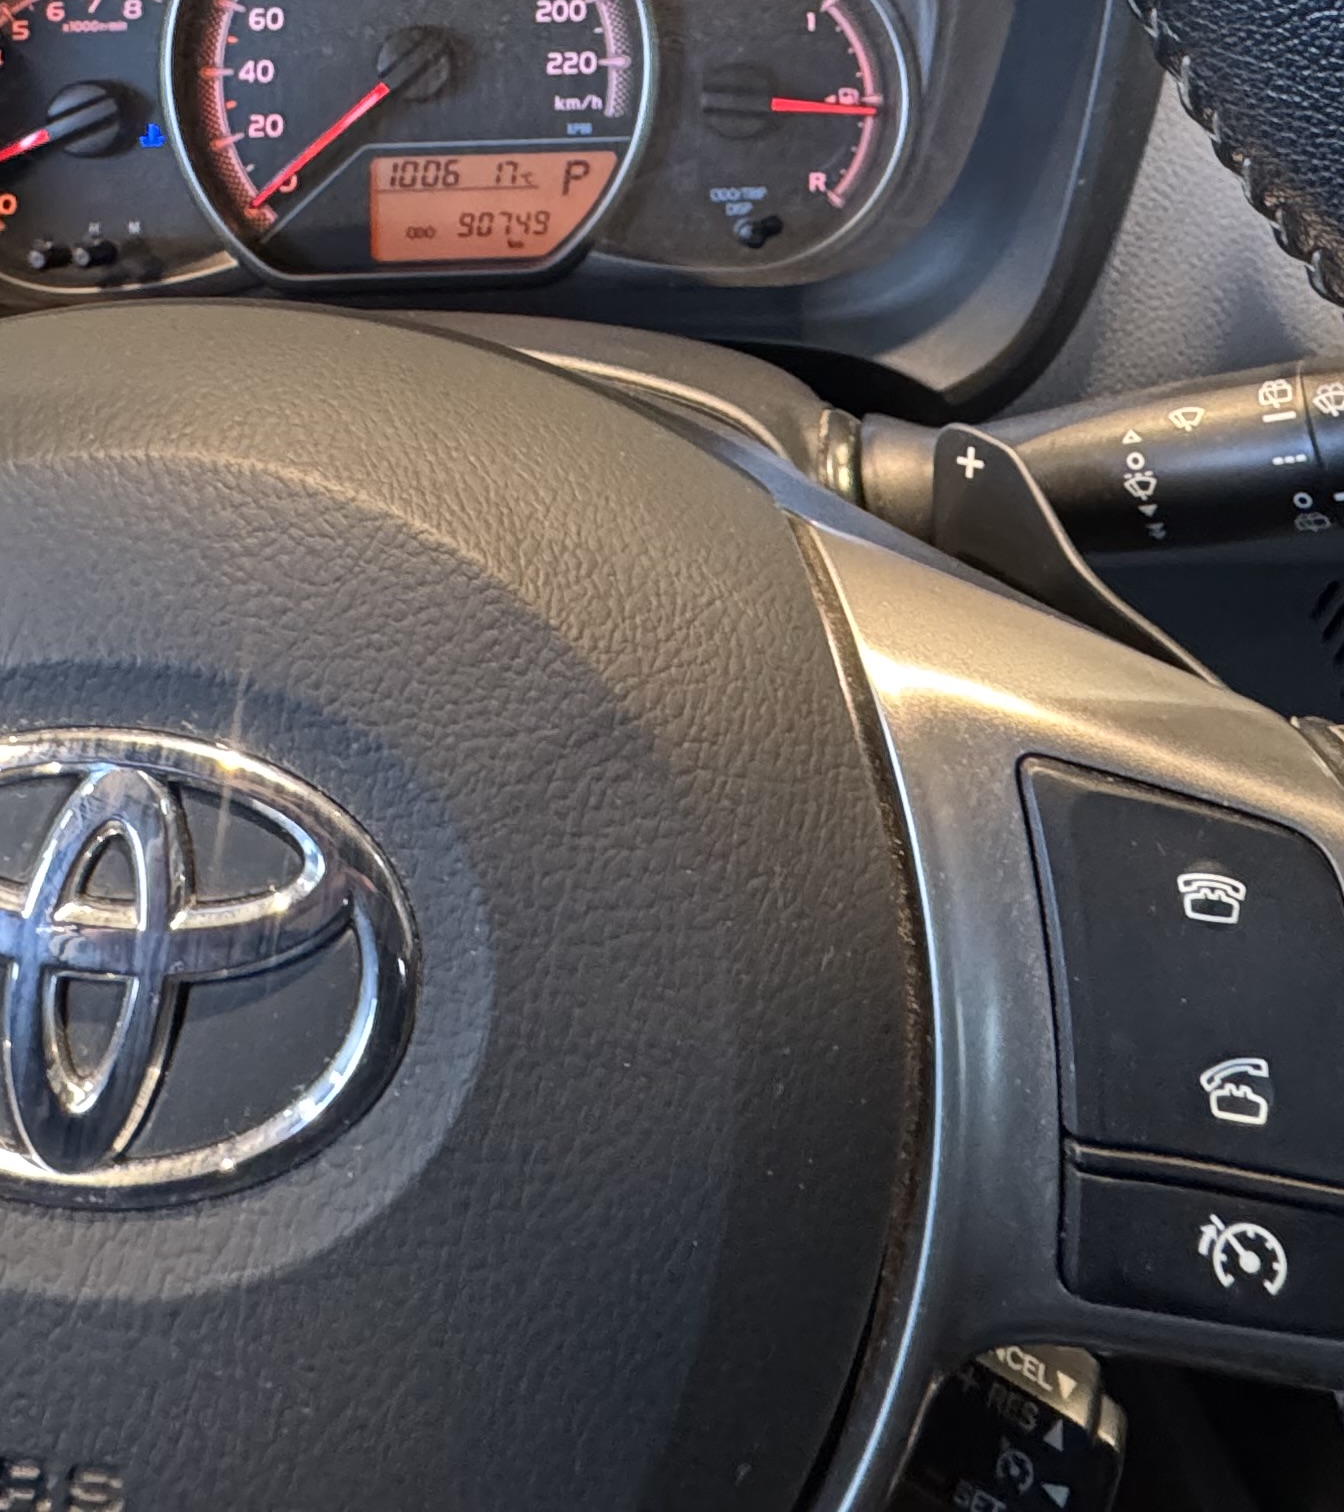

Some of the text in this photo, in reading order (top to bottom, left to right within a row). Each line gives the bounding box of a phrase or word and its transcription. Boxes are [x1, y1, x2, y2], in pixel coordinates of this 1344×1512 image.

[45, 1, 65, 22] 6
[248, 7, 284, 31] 60
[11, 20, 30, 41] 5
[238, 59, 275, 84] 40
[546, 51, 598, 76] 220
[554, 93, 603, 112] km/h
[248, 114, 284, 138] 20
[562, 159, 591, 196] P
[808, 171, 827, 192] R
[457, 210, 551, 239] 90749
